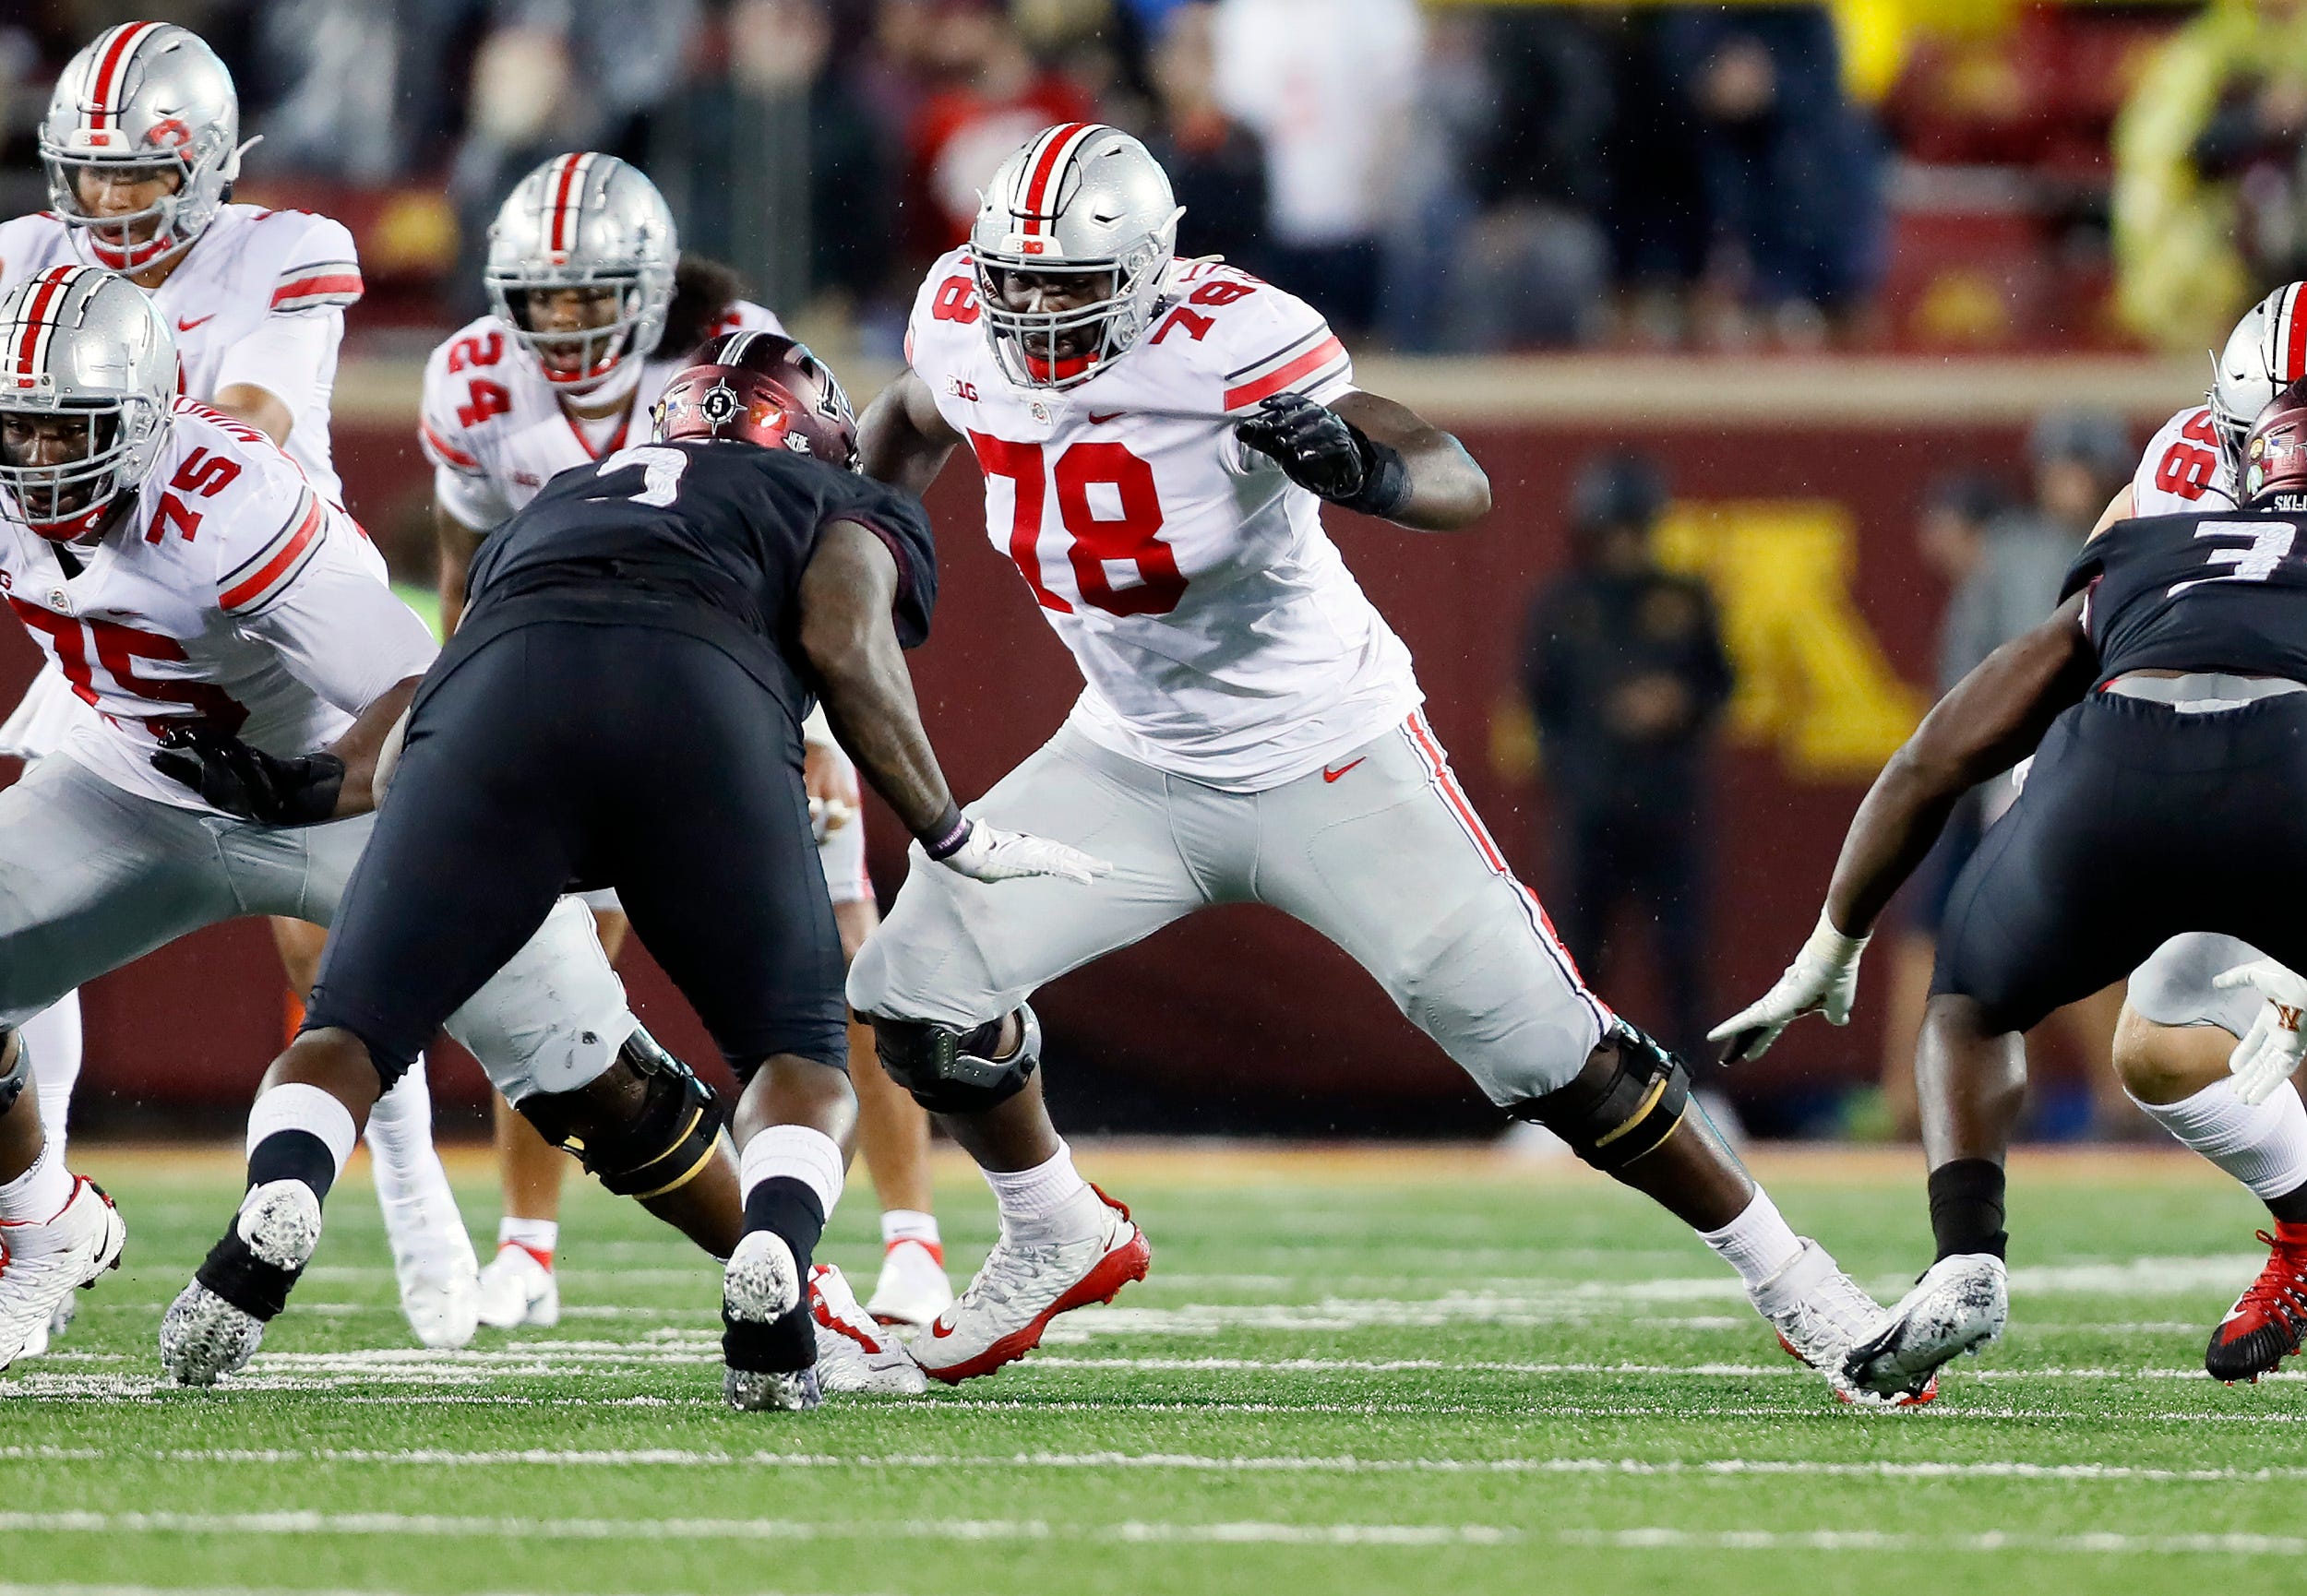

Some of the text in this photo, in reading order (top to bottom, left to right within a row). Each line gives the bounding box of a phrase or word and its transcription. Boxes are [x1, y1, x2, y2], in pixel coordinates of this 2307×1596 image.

[931, 256, 981, 325] 8
[1147, 280, 1258, 345] 78
[448, 330, 512, 429] 24
[711, 397, 723, 413] 5
[145, 447, 242, 545] 75
[966, 427, 1190, 618] 78
[2165, 520, 2298, 599] 3
[7, 594, 251, 739] 75
